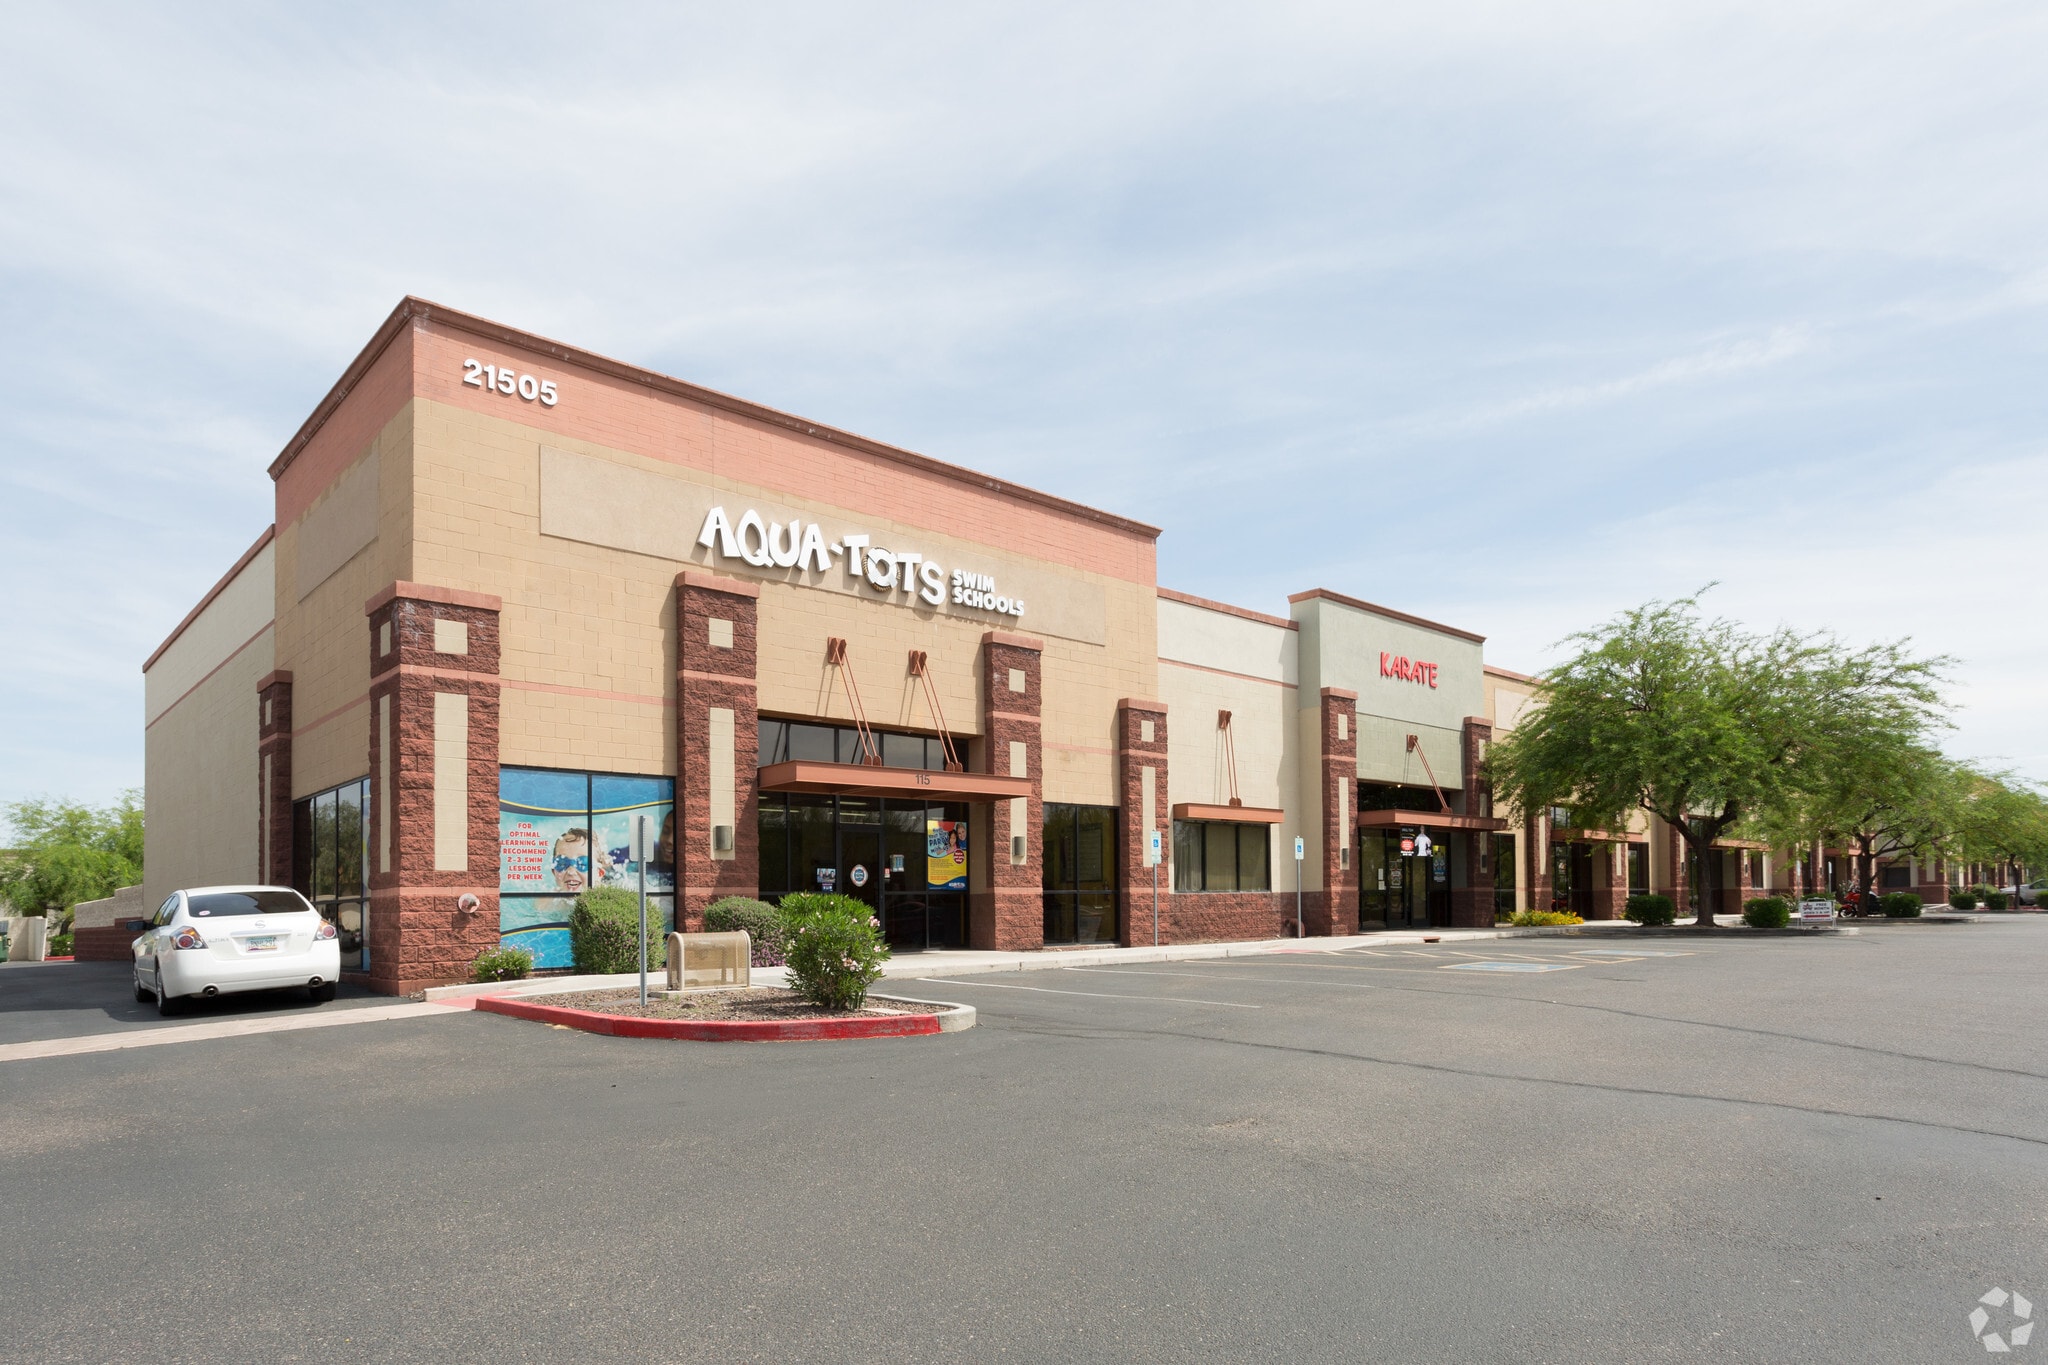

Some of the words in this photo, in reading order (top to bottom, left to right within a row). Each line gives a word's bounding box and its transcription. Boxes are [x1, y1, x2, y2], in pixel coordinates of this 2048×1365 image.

[463, 358, 558, 406] 21505
[697, 506, 947, 606] AQUA-TOTS
[951, 568, 995, 593] SWIM
[951, 586, 1025, 617] SCHOOLS
[1380, 651, 1439, 689] KARATE
[915, 773, 931, 785] 115
